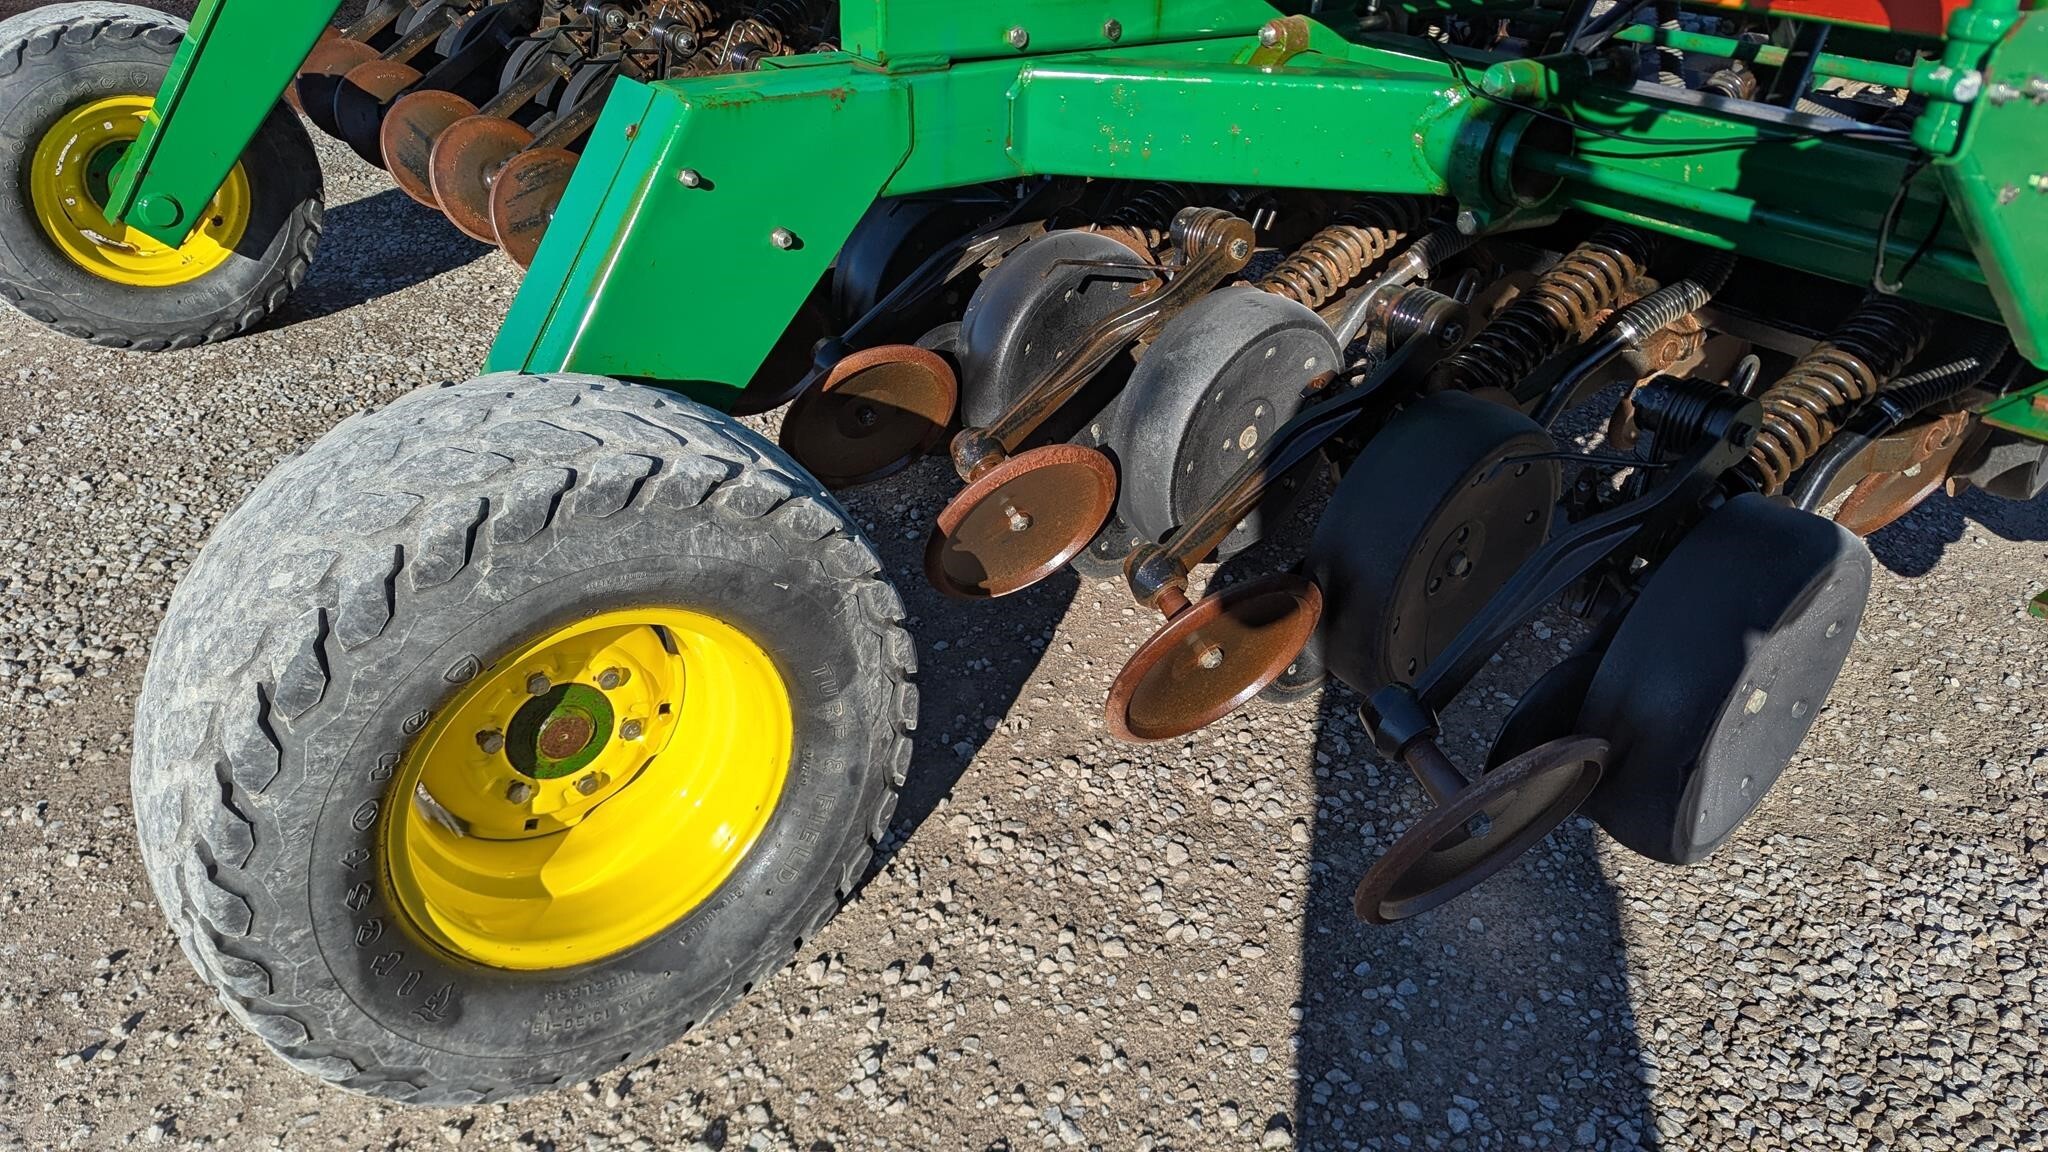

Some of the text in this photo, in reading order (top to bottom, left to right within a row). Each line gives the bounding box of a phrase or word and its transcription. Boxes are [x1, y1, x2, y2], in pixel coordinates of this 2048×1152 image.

[339, 708, 456, 1024] Firestone
[776, 662, 847, 885] TURF & FIELD
[544, 969, 638, 1003] TUBELESS
